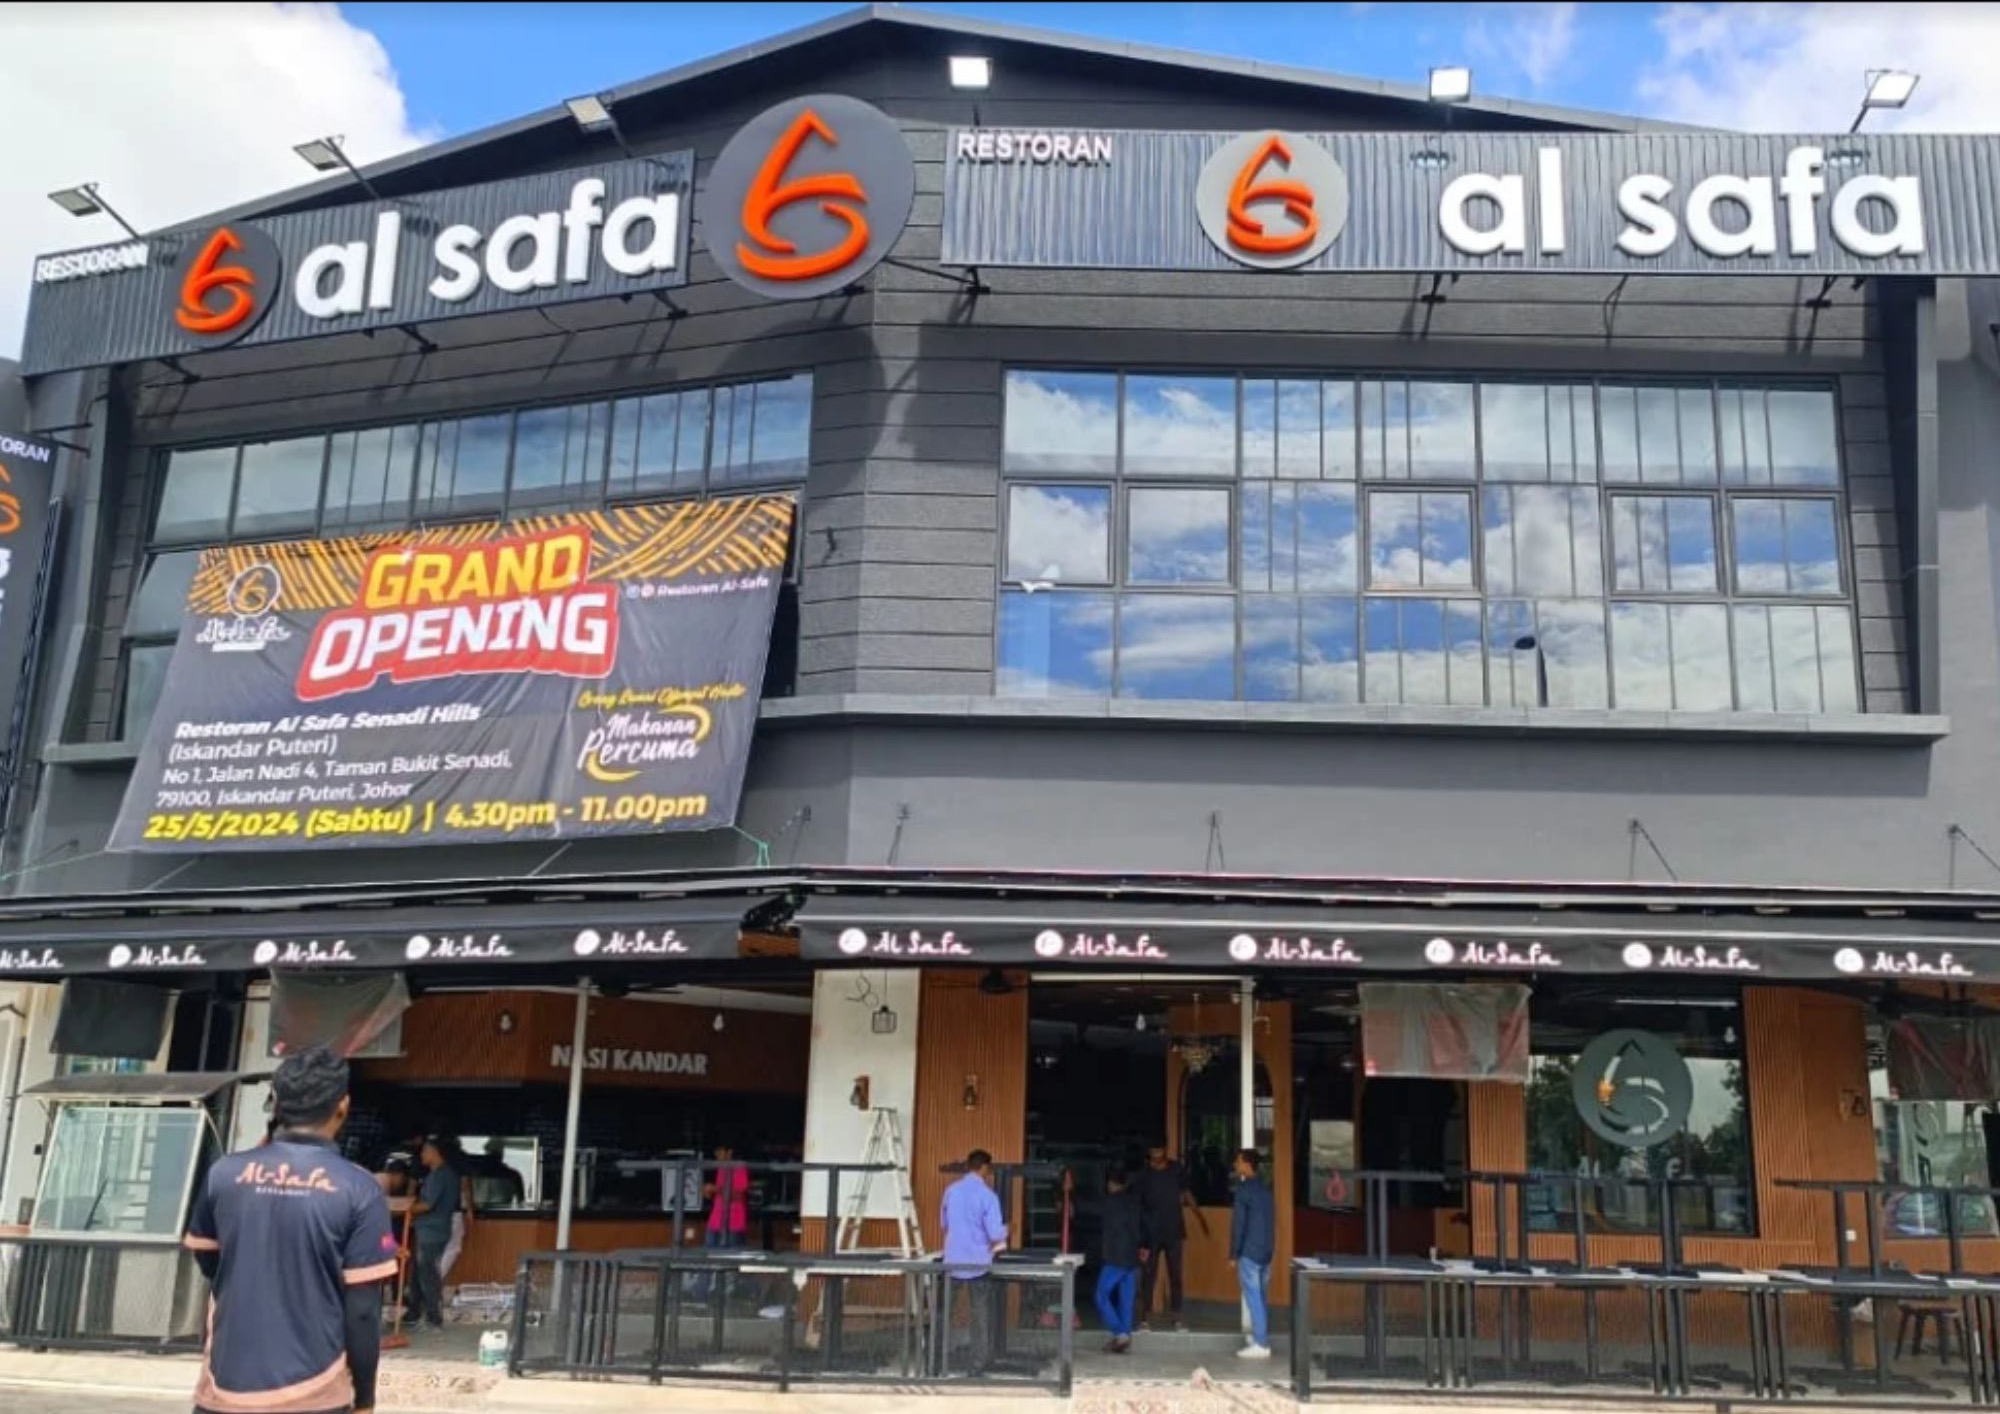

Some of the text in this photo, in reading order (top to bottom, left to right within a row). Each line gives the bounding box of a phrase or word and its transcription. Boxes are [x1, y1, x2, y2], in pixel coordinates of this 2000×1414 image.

[957, 132, 1113, 160] RESTORAN
[1439, 146, 1924, 256] al safa
[37, 243, 149, 282] RESTORAN
[295, 178, 679, 318] al safa
[0, 435, 50, 462] ORAN
[364, 534, 583, 609] GRAND
[309, 592, 608, 681] OPENING
[175, 702, 482, 739] Restoran Al Safa Senadi Hills
[606, 711, 696, 740] Makanan
[169, 734, 337, 763] (Iskandar Puteri)
[577, 729, 698, 769] Percuma
[163, 768, 188, 784] No
[206, 765, 253, 782] Jalan
[258, 763, 300, 780] Nadi
[325, 760, 386, 777] Taman
[391, 754, 438, 774] Bukit
[217, 786, 295, 806] Iskandar
[360, 782, 413, 799] Johor
[144, 809, 299, 839] 25/5/2024
[305, 804, 412, 838] (Sabtu)
[445, 802, 556, 832] 4.30pm
[580, 794, 707, 825] 11.00pm
[613, 1049, 708, 1075] KANDAR
